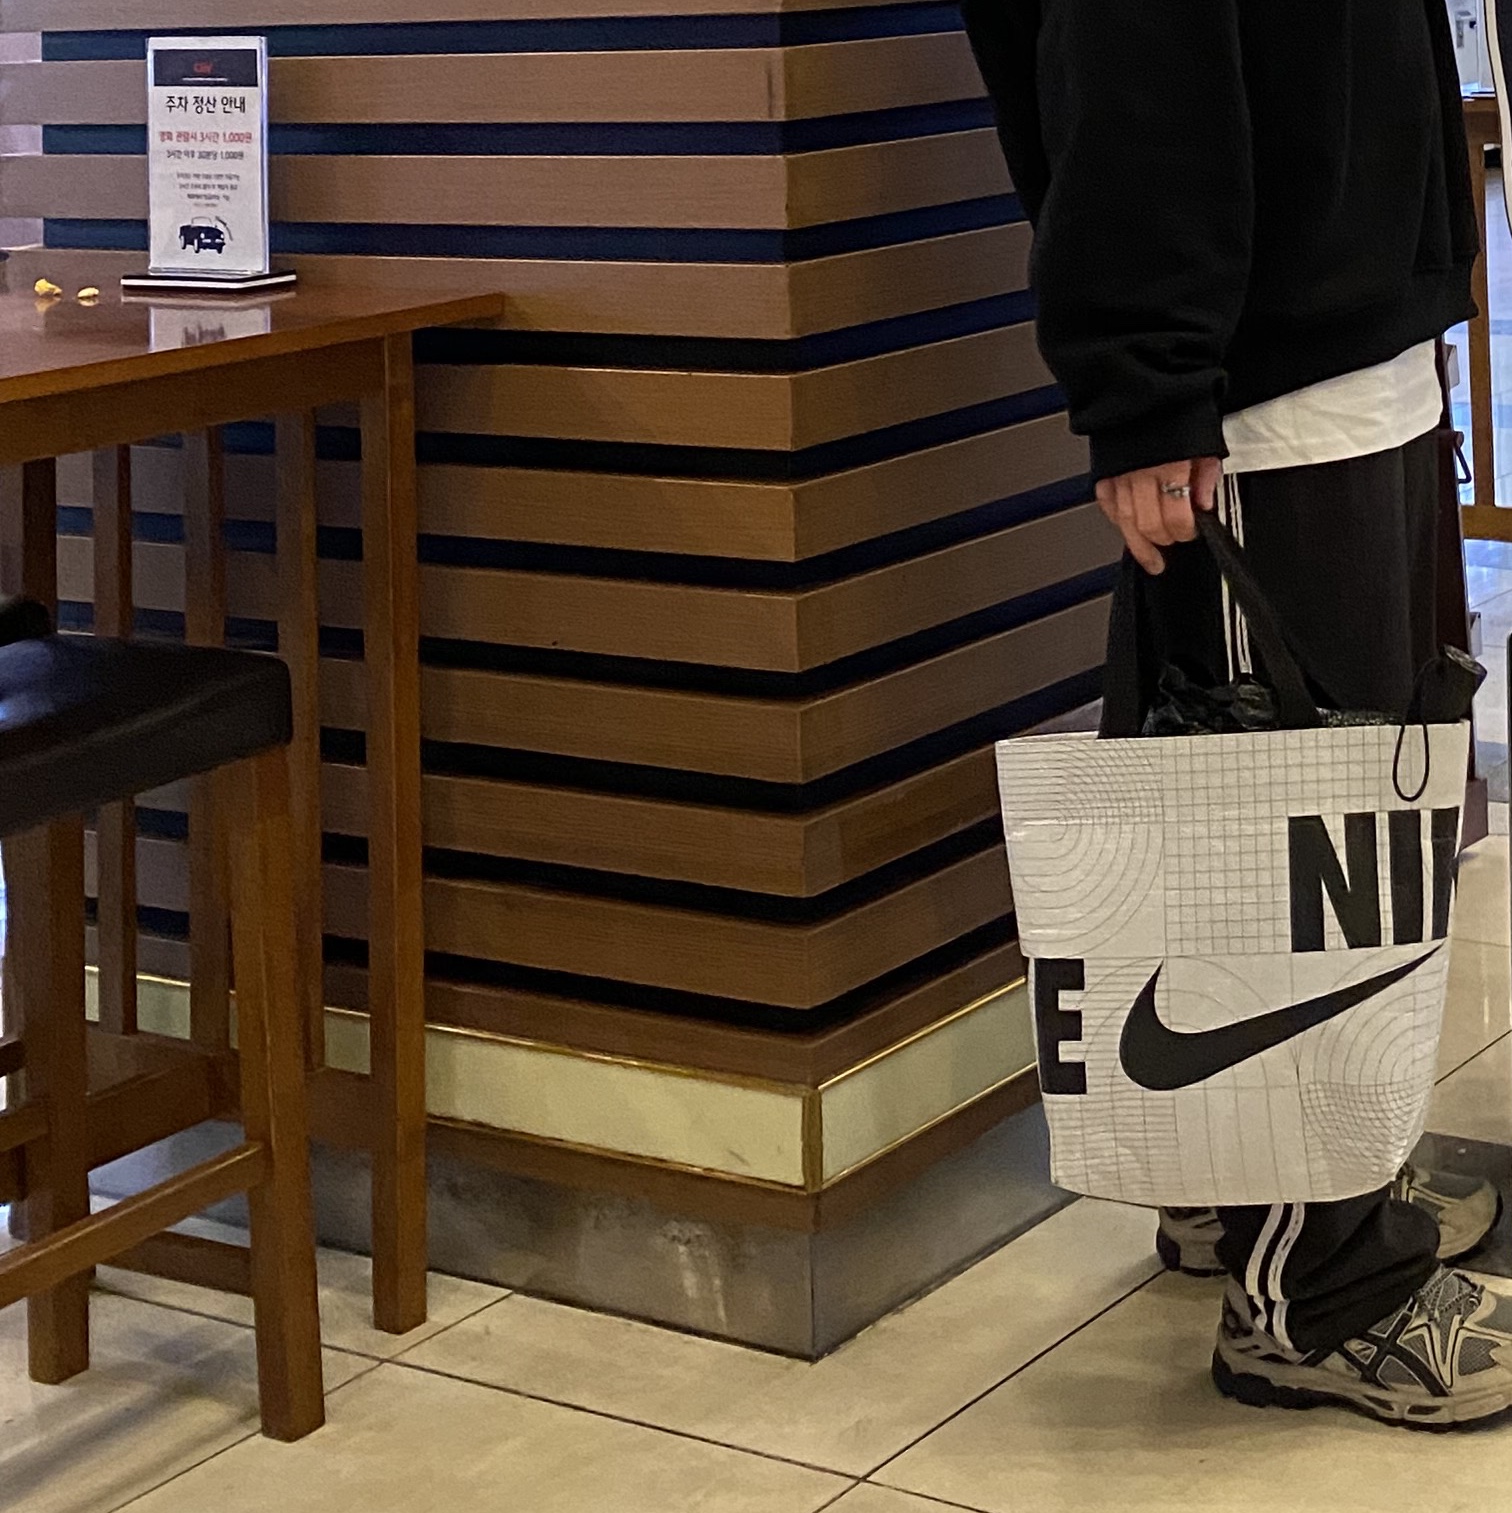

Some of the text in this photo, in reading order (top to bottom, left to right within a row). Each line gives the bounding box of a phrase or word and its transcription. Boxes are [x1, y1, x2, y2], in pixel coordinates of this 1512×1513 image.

[166, 95, 246, 114] 주차 정산 안내
[1033, 958, 1087, 1095] E
